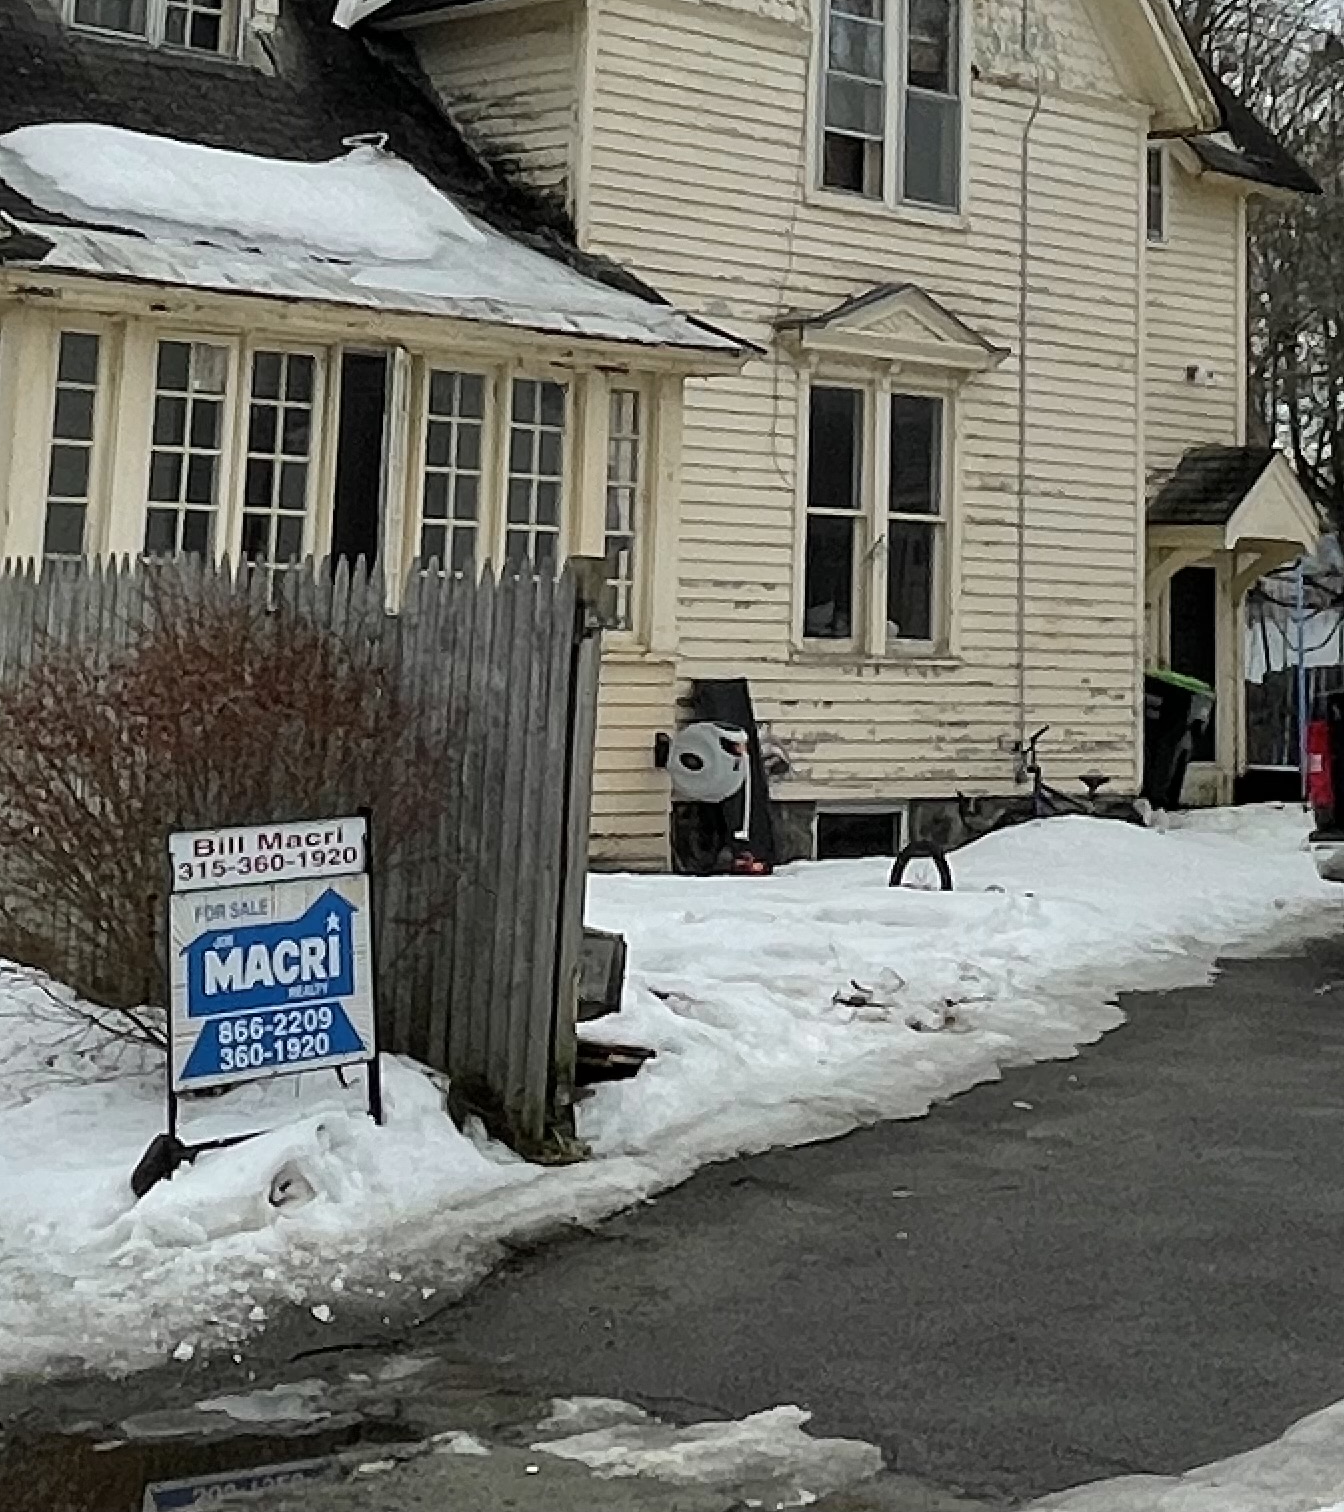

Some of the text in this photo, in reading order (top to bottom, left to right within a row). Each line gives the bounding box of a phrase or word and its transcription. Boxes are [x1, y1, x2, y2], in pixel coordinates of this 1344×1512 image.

[194, 826, 344, 857] Bill Macri
[178, 846, 358, 881] 315-360-1920
[194, 897, 268, 923] FOR SALE
[218, 1006, 332, 1044] 866-2209
[219, 1032, 330, 1070] 360-1920
